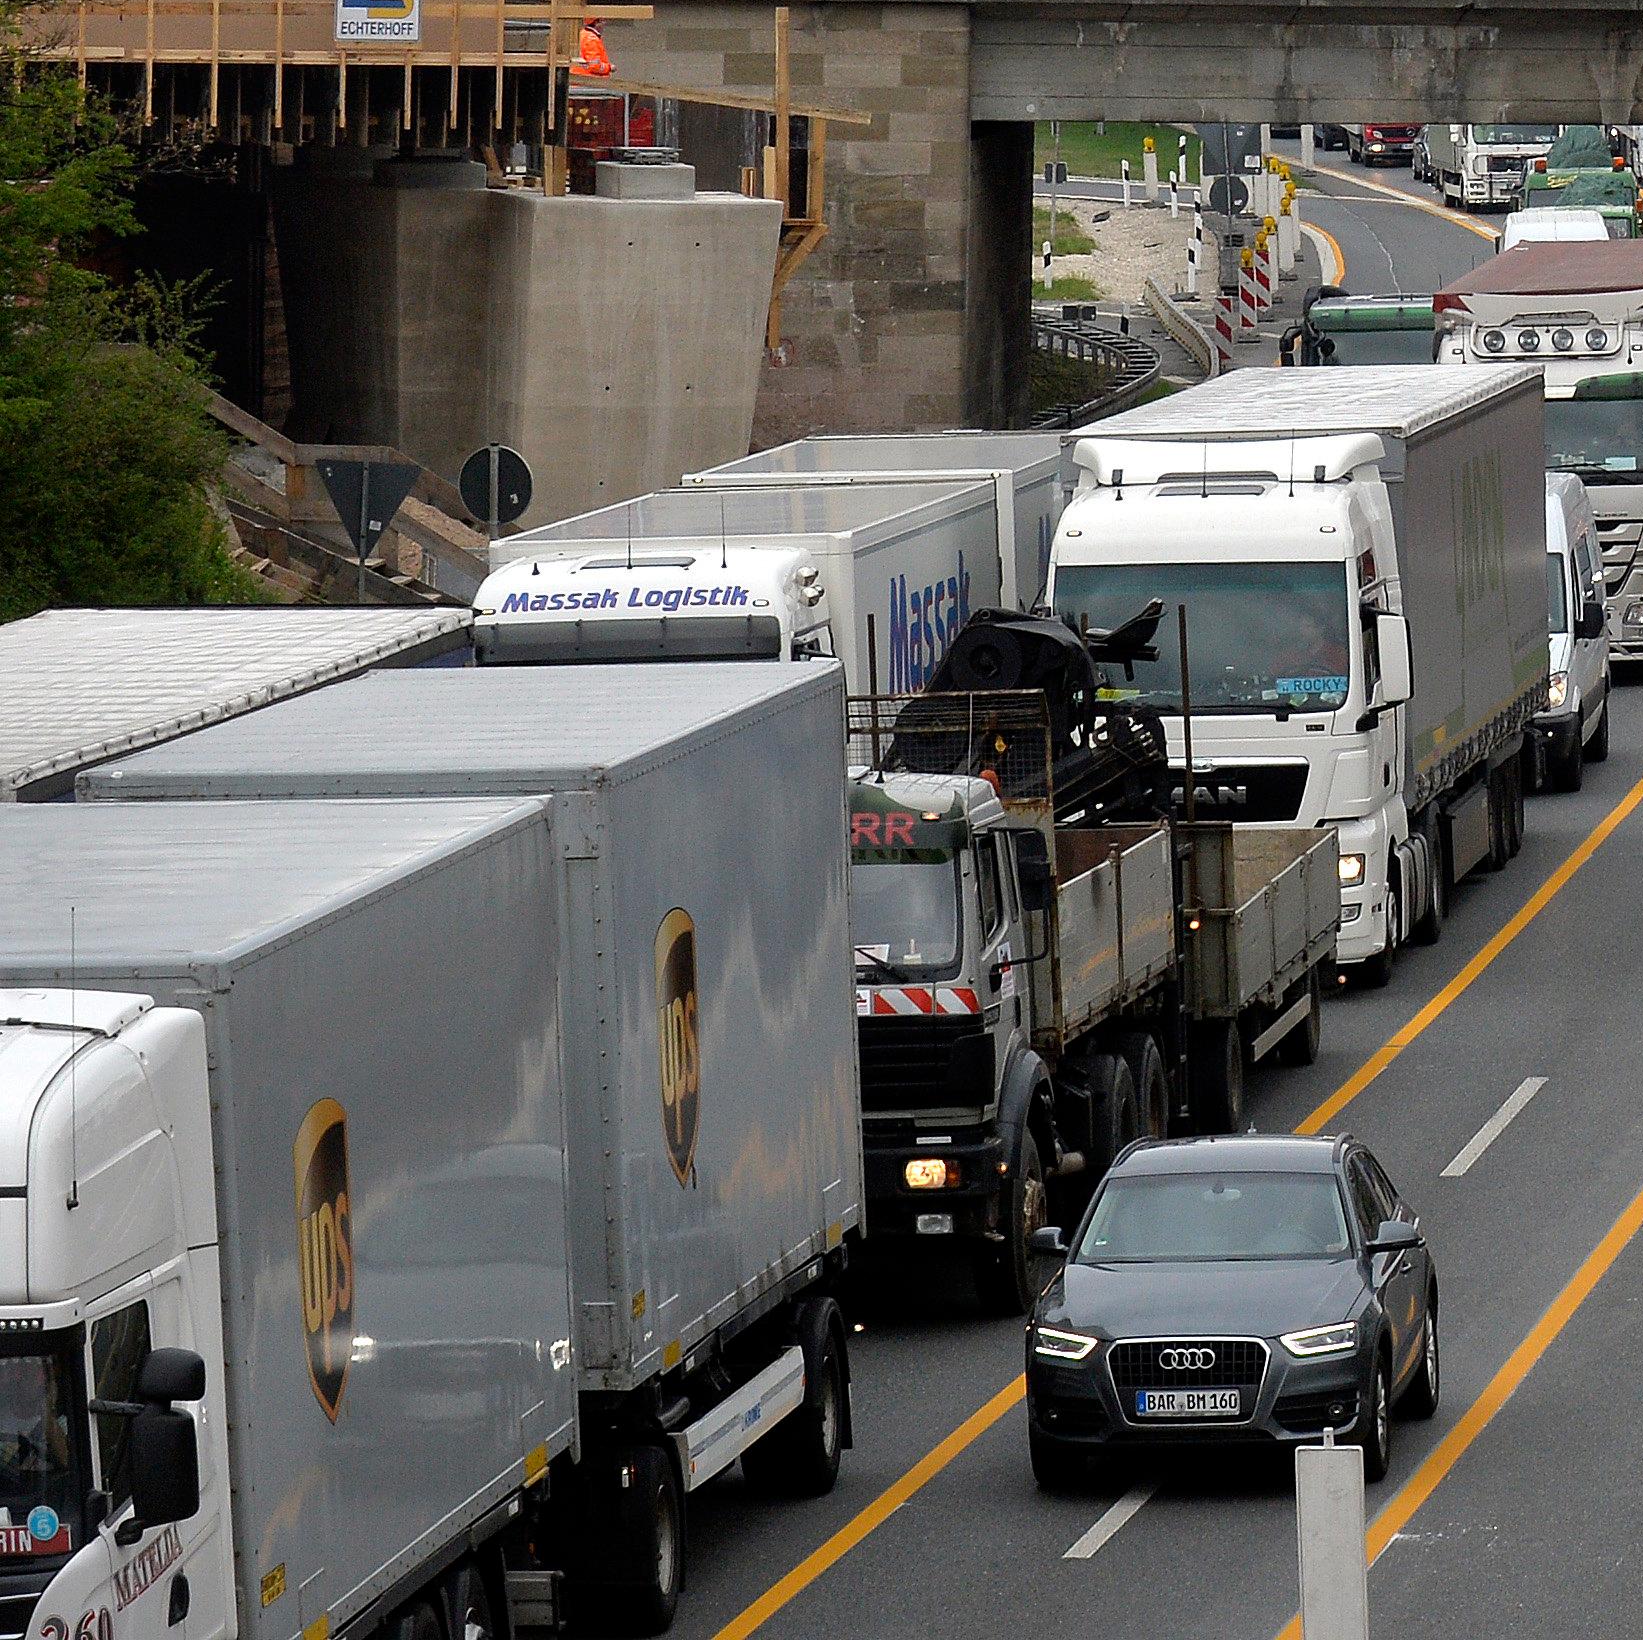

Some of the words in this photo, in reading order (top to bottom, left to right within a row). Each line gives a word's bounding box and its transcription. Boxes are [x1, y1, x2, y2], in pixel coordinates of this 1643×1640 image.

[340, 21, 414, 36] ECHTERHOFF
[502, 589, 619, 613] Massak
[628, 586, 749, 611] Logistik
[1293, 678, 1341, 691] ROCKY
[659, 990, 697, 1145] ups
[301, 1193, 349, 1374] ups
[1147, 1394, 1175, 1410] BAR
[1186, 1393, 1206, 1410] BM
[1210, 1392, 1237, 1410] 160
